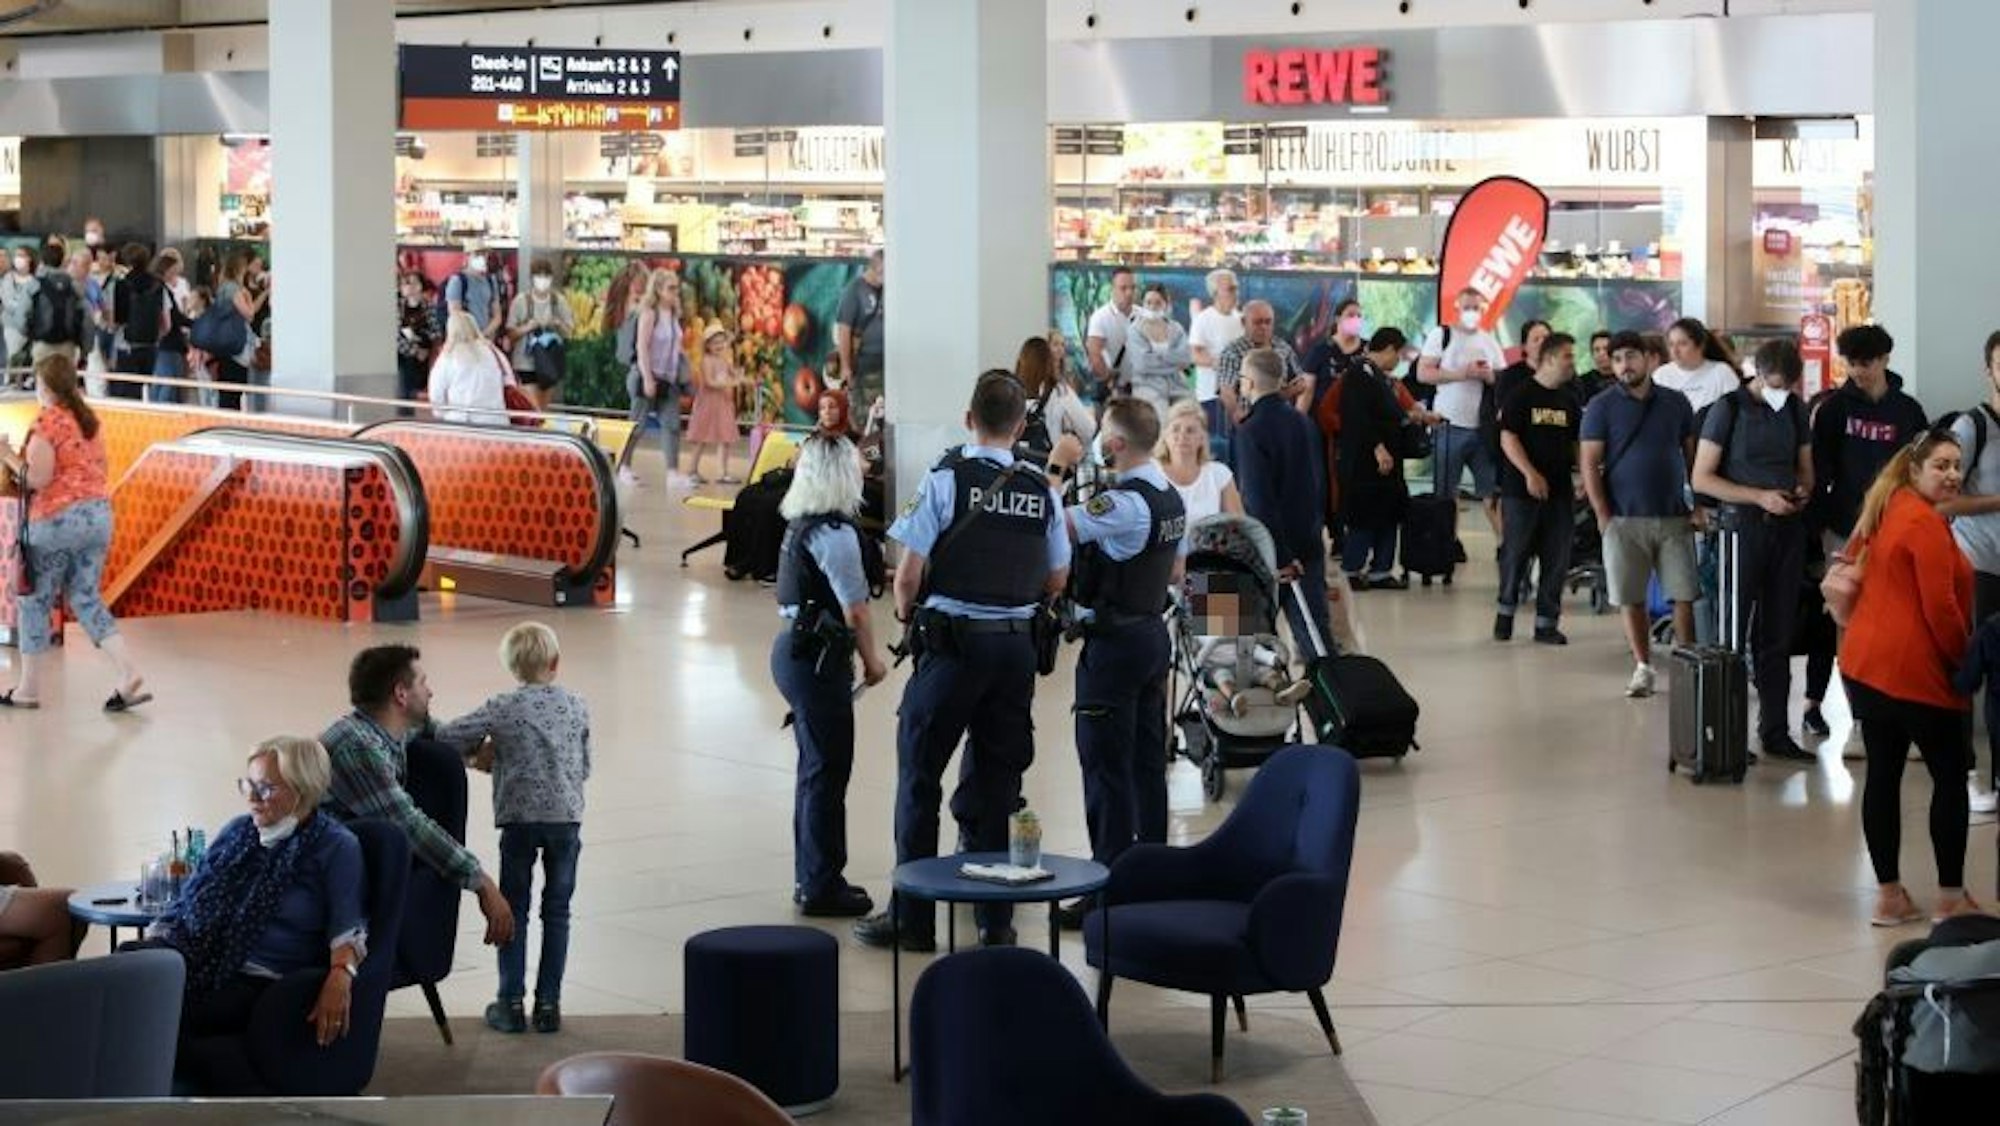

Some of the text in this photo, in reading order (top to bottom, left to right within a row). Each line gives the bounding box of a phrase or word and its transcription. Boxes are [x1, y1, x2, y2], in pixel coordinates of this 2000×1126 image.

[471, 54, 527, 72] Check-in
[566, 56, 616, 73] Ankunft
[617, 57, 626, 74] 2
[642, 57, 651, 74] 3
[1243, 47, 1386, 106] REWE
[566, 78, 615, 94] Arrivals
[617, 79, 626, 95] 2
[642, 79, 651, 95] 3
[1585, 127, 1661, 173] WURST
[1468, 214, 1538, 305] EWE
[968, 486, 1046, 520] POLIZEI
